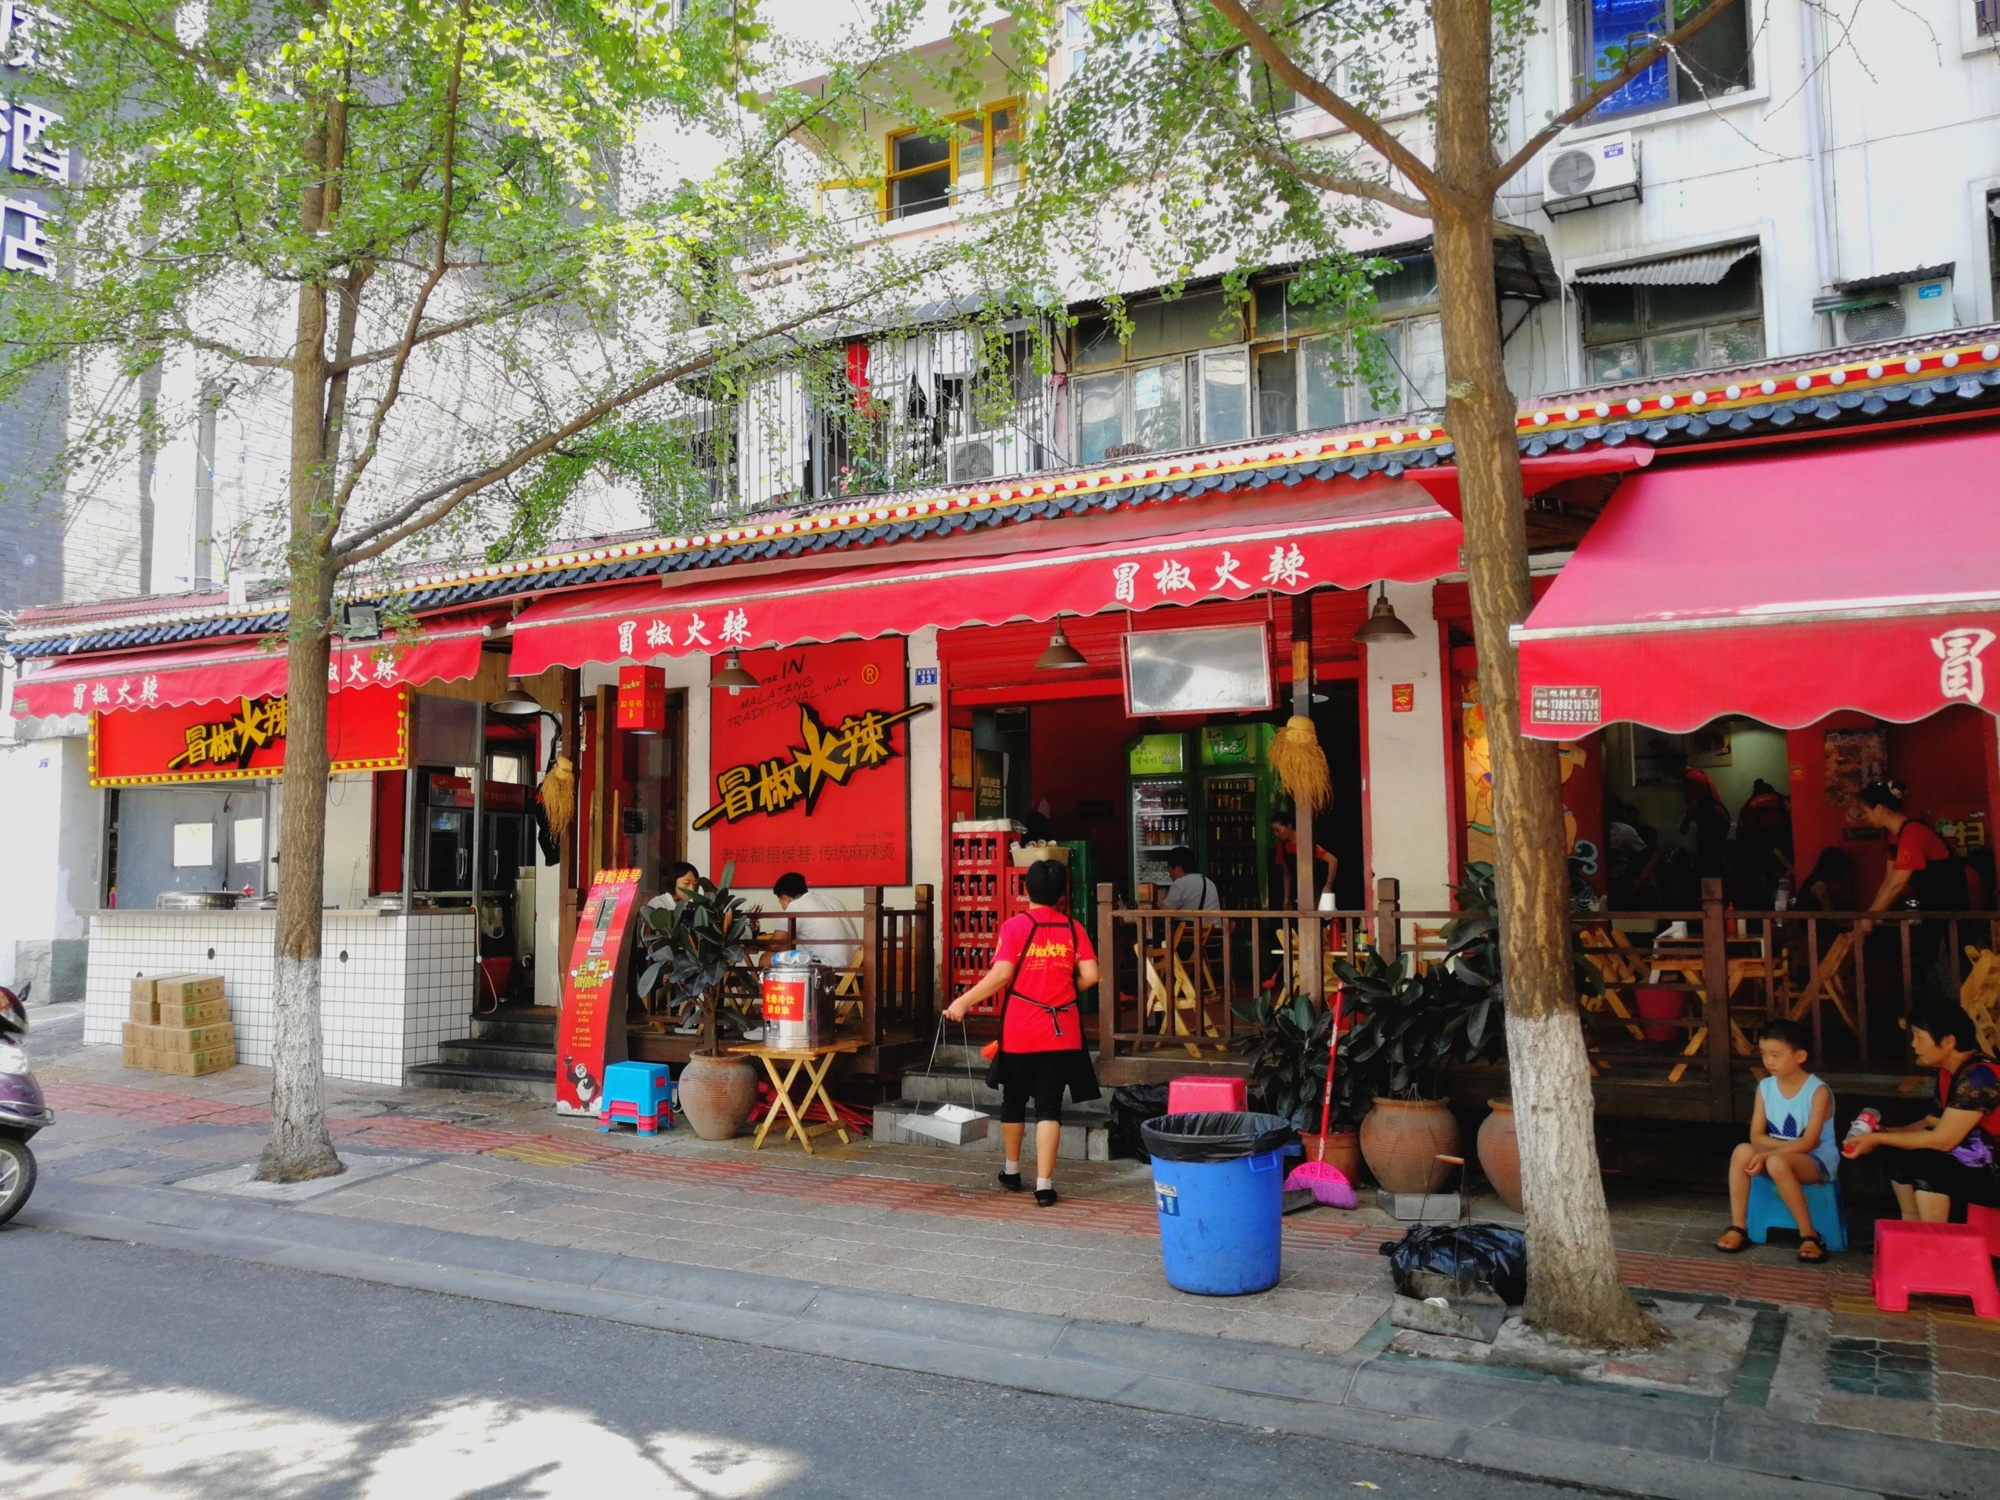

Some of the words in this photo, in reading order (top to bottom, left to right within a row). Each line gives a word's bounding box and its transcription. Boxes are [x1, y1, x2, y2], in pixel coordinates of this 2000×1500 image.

[1112, 543, 1310, 603] 冒椒火辣
[618, 607, 752, 655] 冒椒火辣
[782, 653, 805, 679] IN
[920, 675, 931, 684] 33
[1929, 627, 1997, 704] 冒
[72, 675, 159, 710] 冒椒火辣
[726, 689, 819, 728] TRADITIONAL
[167, 697, 287, 769] 冒椒火辣
[694, 703, 930, 829] 冒椒火辣
[594, 869, 642, 885] 自助排号
